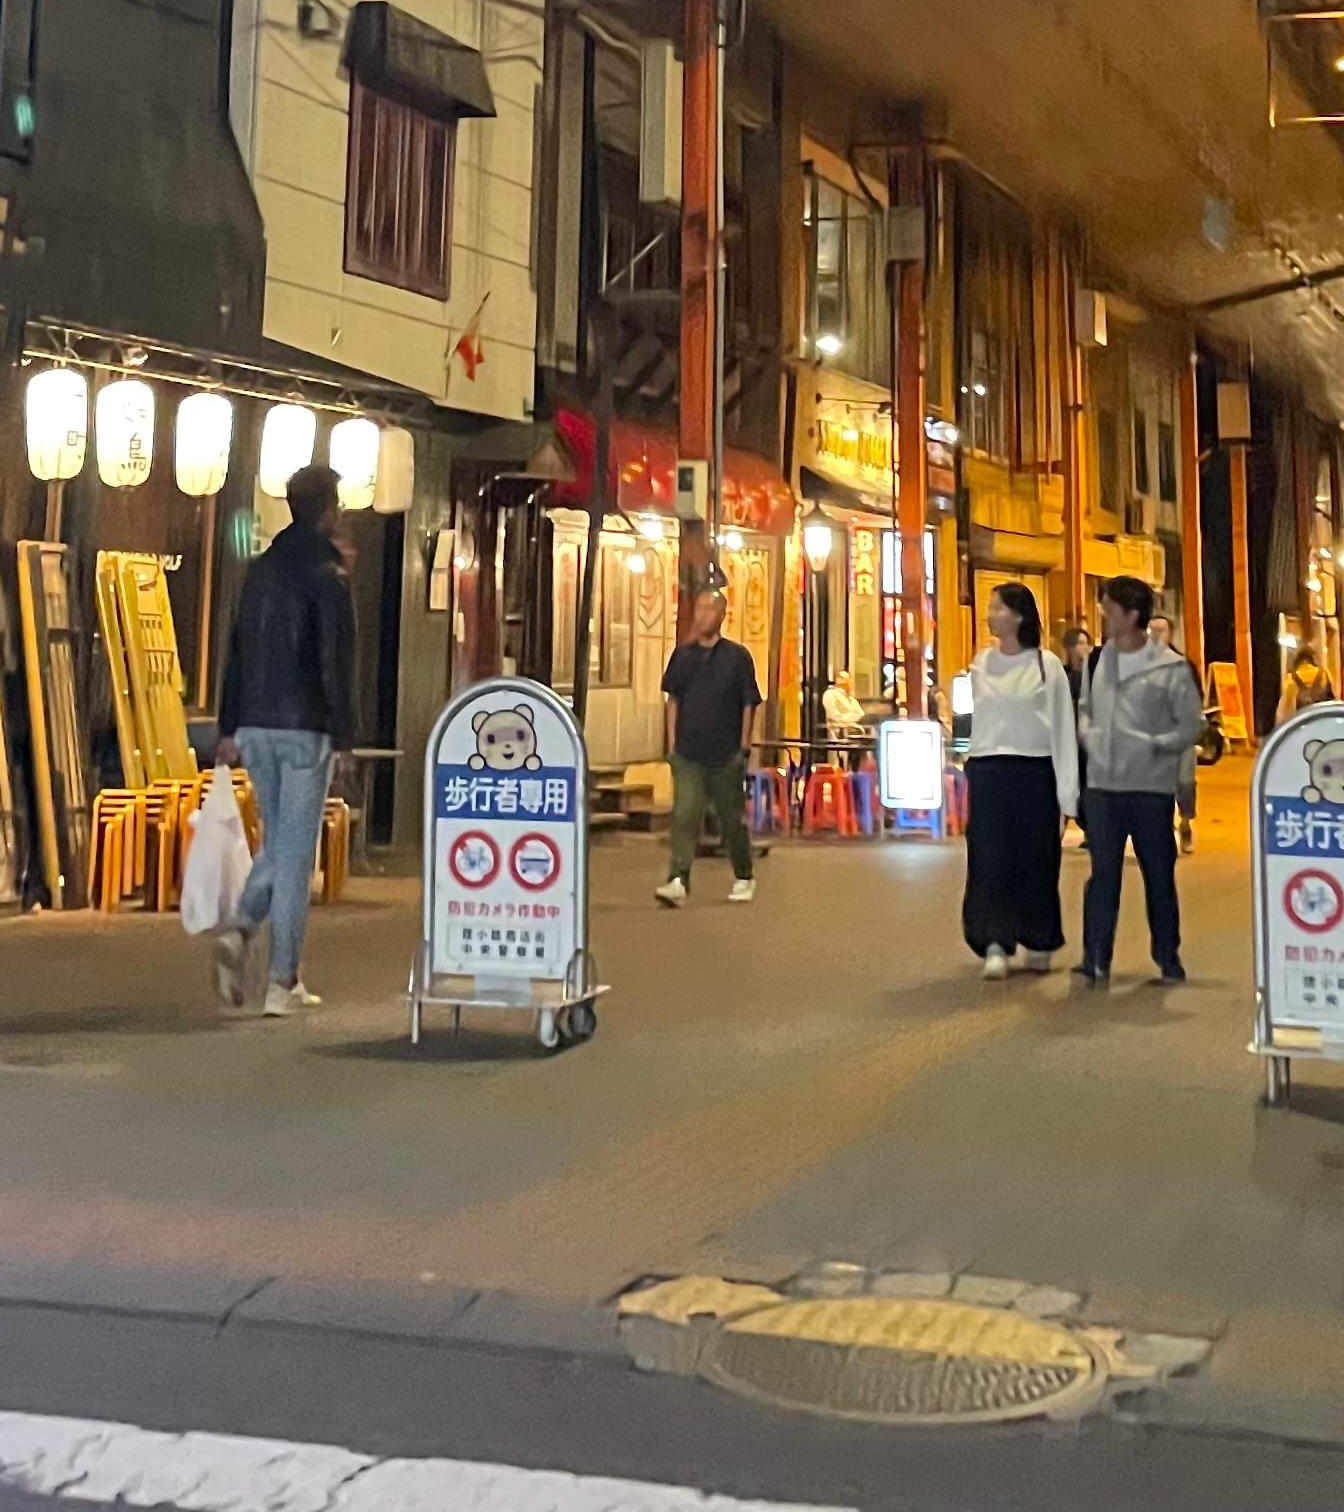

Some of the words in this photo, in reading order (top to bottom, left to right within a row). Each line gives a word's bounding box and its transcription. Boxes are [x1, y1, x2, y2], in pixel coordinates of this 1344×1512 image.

[856, 530, 875, 595] BAR
[445, 777, 568, 814] 歩行者専用
